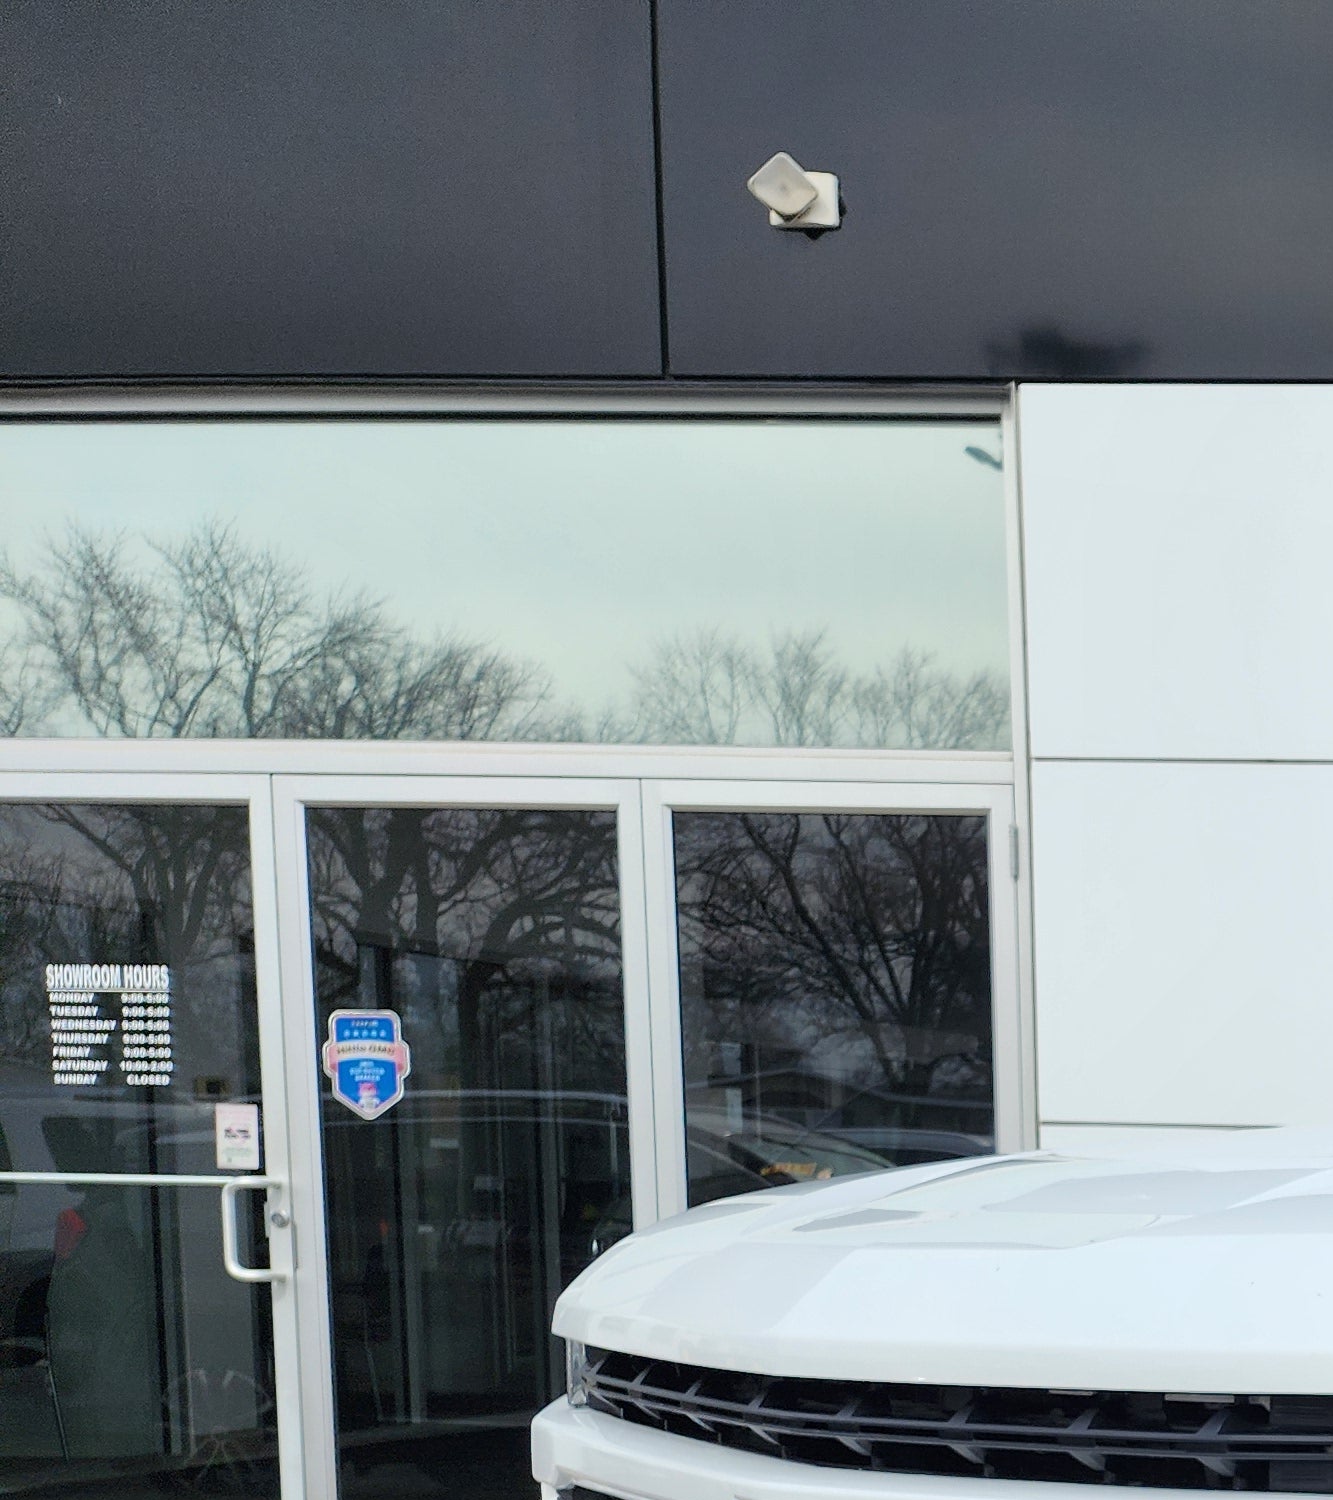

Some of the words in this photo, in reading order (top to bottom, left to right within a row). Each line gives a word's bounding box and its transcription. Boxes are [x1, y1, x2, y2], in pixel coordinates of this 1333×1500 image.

[46, 964, 121, 989] SHOWROOM
[124, 964, 169, 990] HOURS
[49, 992, 94, 1003] MONDAY
[49, 1006, 98, 1016] TUESDAY
[50, 1019, 116, 1030] WEDNESDAY
[51, 1033, 109, 1044] THURSDAY
[52, 1046, 91, 1057] FRIDAY
[52, 1060, 108, 1071] SATURDAY
[54, 1074, 97, 1085] SUNDAY
[126, 1075, 170, 1085] CLOSED
